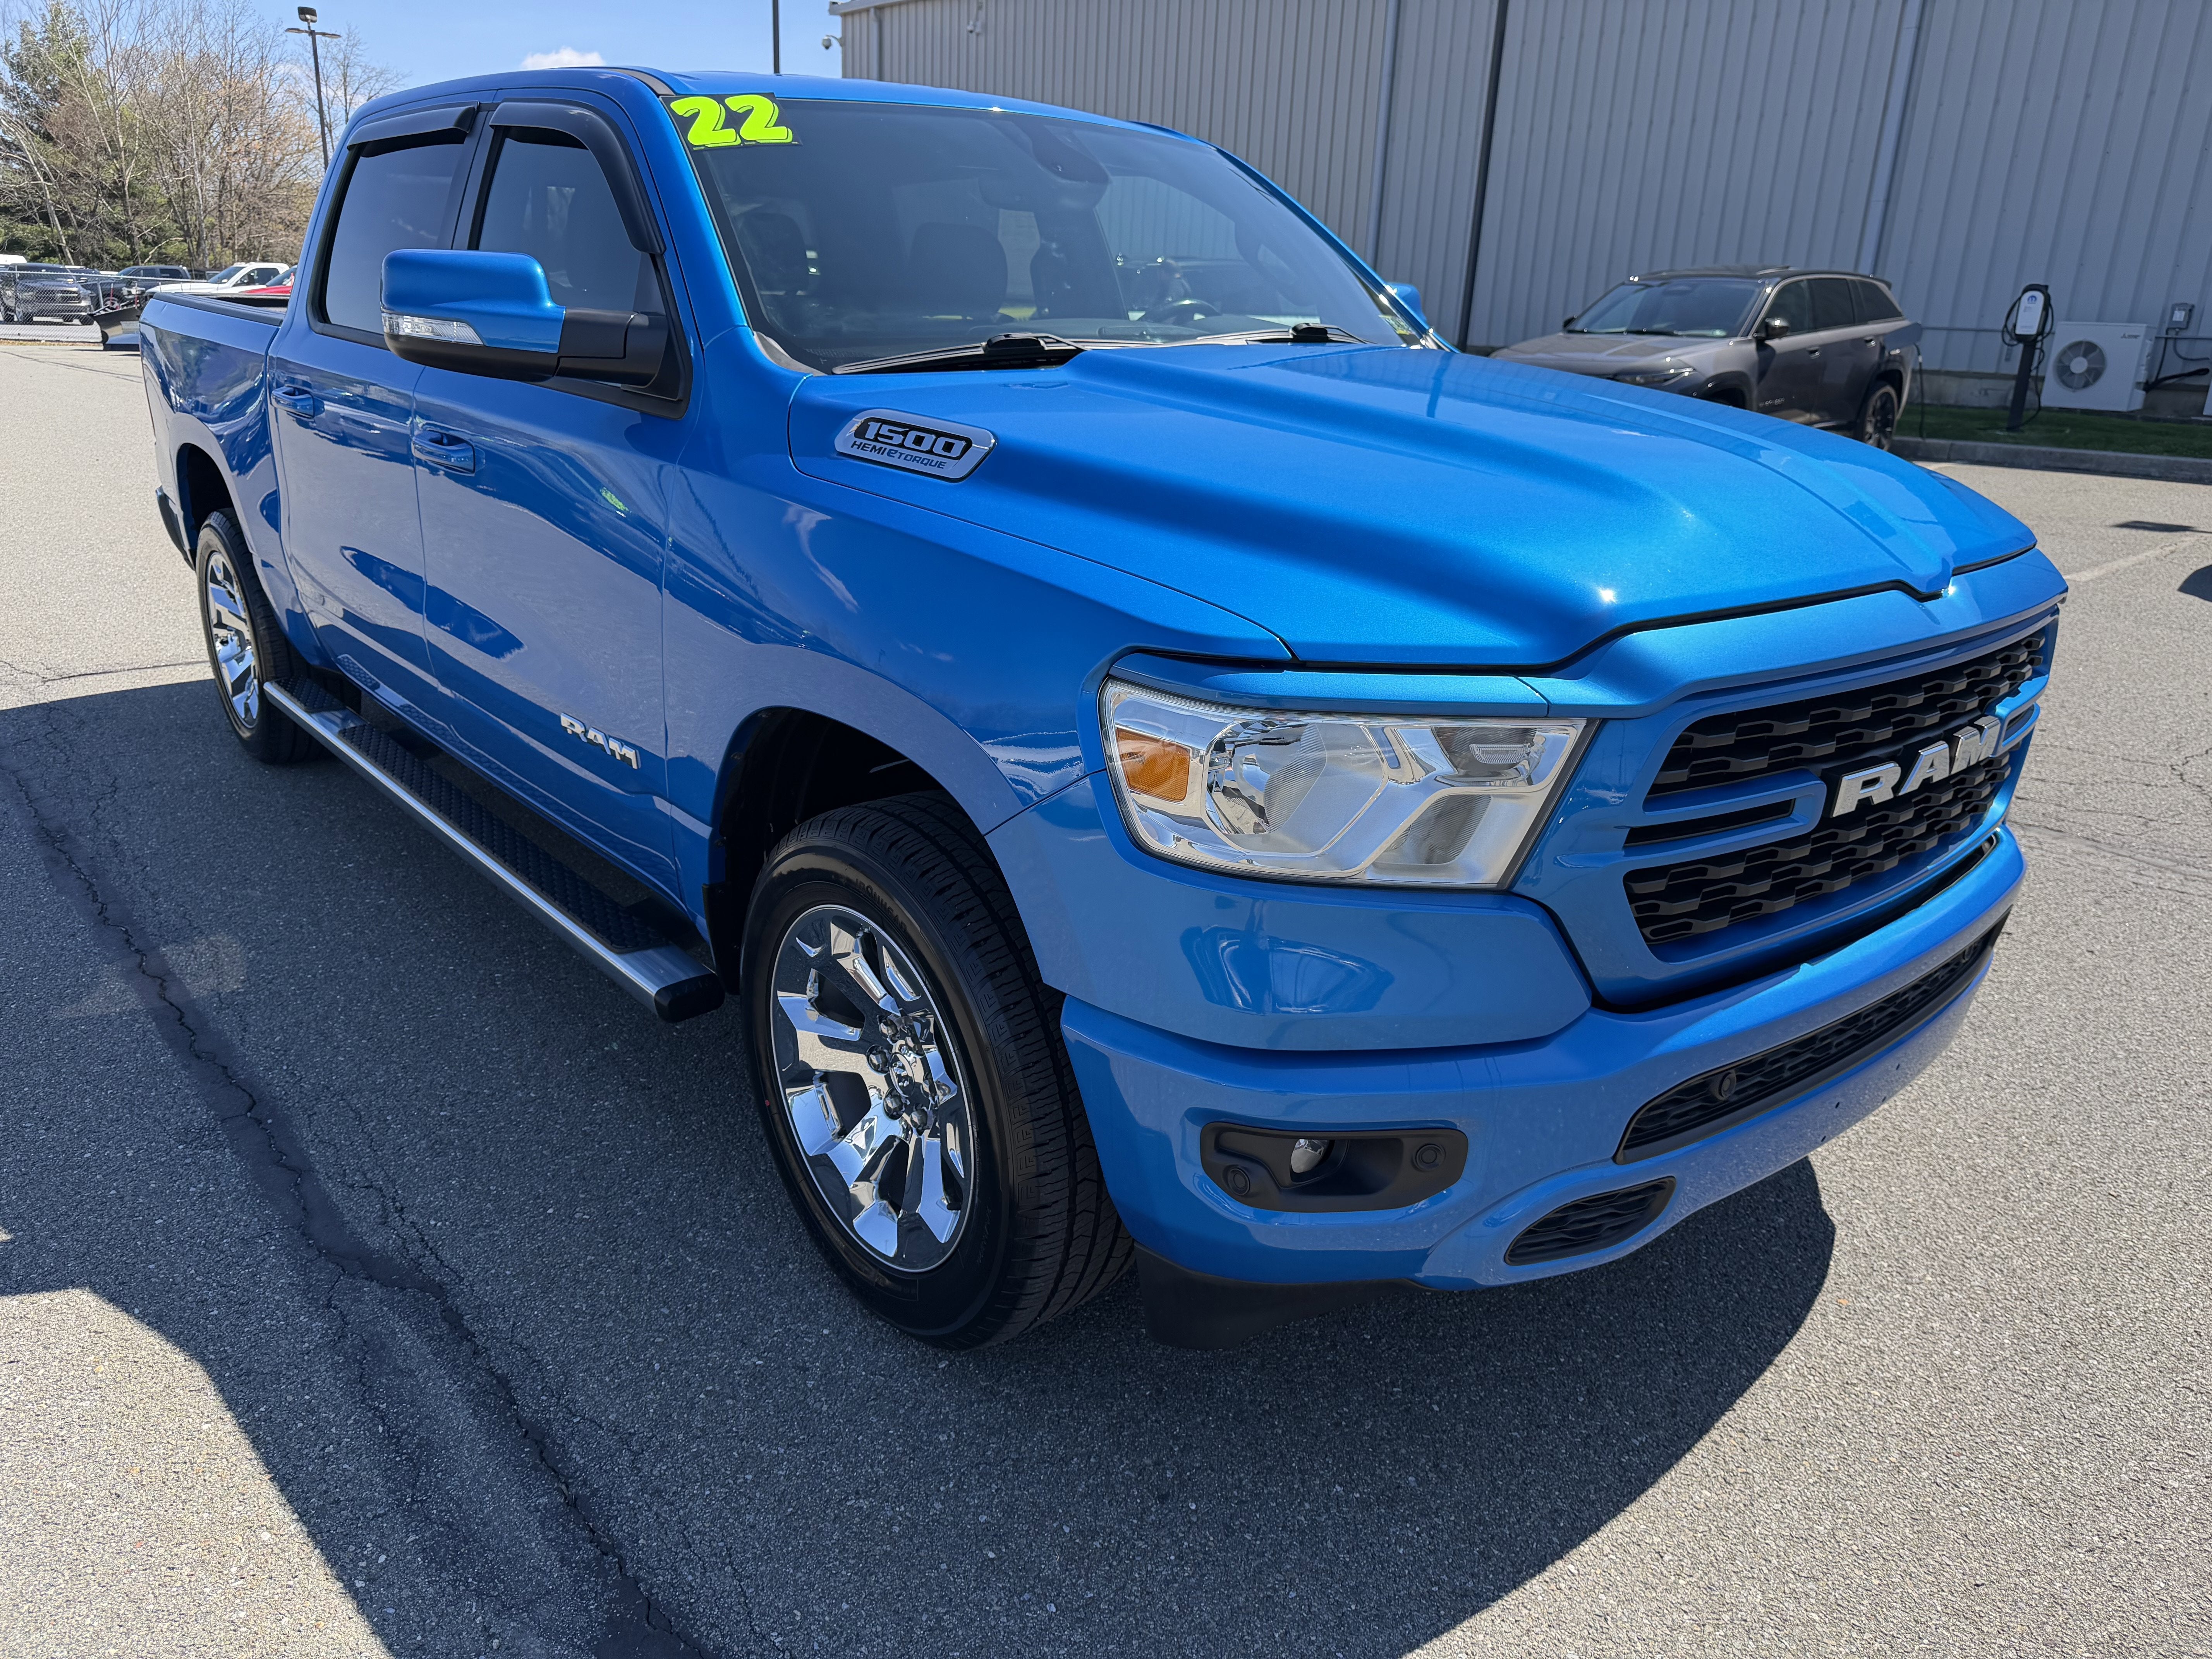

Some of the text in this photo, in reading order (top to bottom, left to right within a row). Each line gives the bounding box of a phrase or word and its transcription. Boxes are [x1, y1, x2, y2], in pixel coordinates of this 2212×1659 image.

[670, 94, 793, 148] 22
[851, 440, 886, 456] HEMI
[865, 421, 967, 457] 1500
[561, 712, 639, 769] RAM
[1832, 716, 2001, 817] RAM
